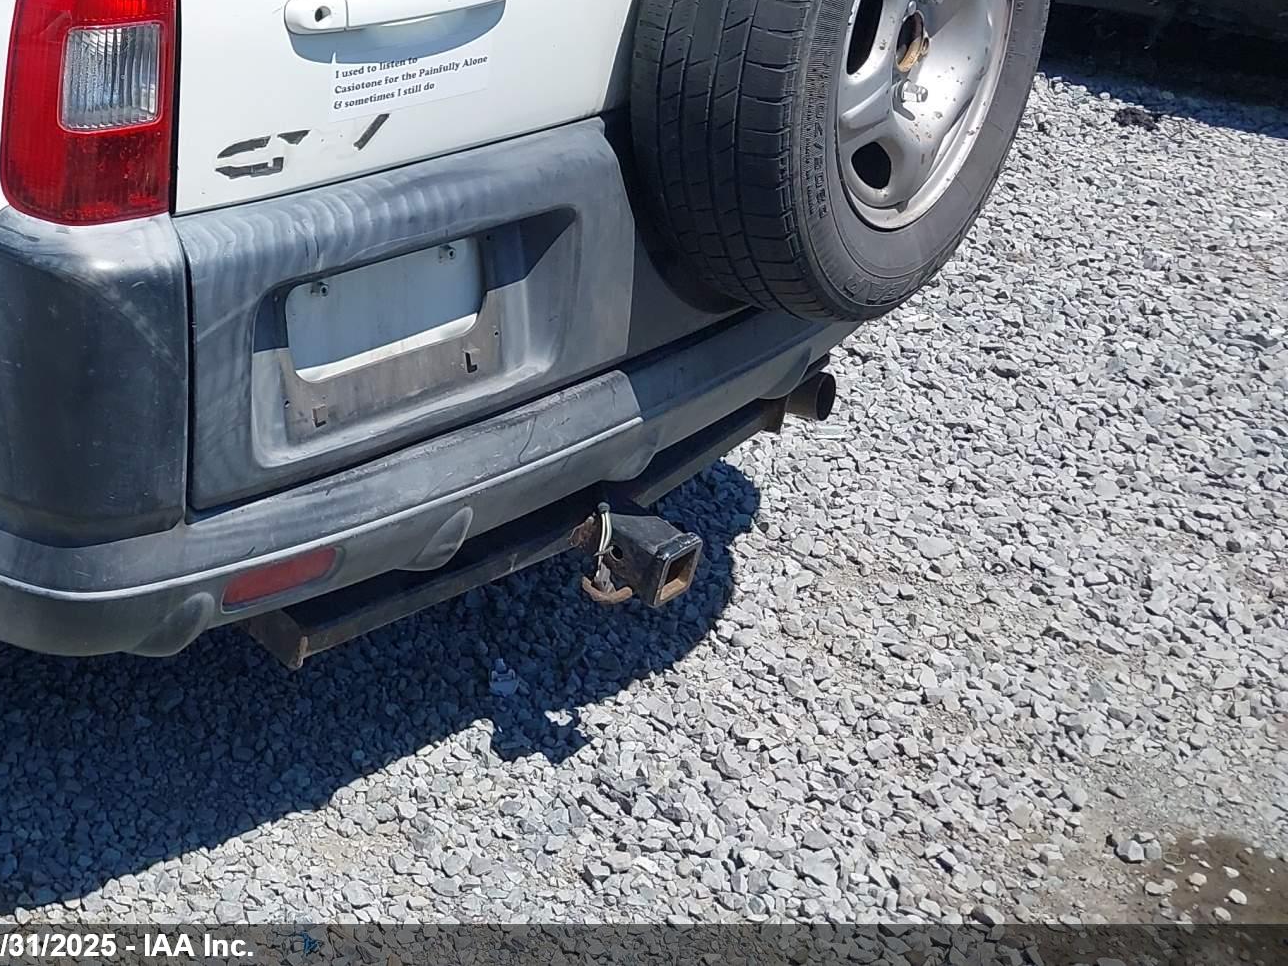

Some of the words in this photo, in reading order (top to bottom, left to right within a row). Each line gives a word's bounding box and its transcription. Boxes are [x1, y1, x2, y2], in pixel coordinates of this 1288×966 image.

[334, 80, 383, 94] Casiotone
[384, 76, 399, 85] for
[401, 70, 417, 81] the
[418, 62, 460, 77] Painfully
[462, 56, 488, 68] Alone
[342, 67, 364, 77] used
[367, 63, 377, 73] to
[379, 59, 405, 71] listen
[407, 57, 418, 65] to
[333, 101, 343, 110] &
[344, 91, 395, 108] sometimes
[403, 84, 422, 95] still
[423, 82, 435, 91] do
